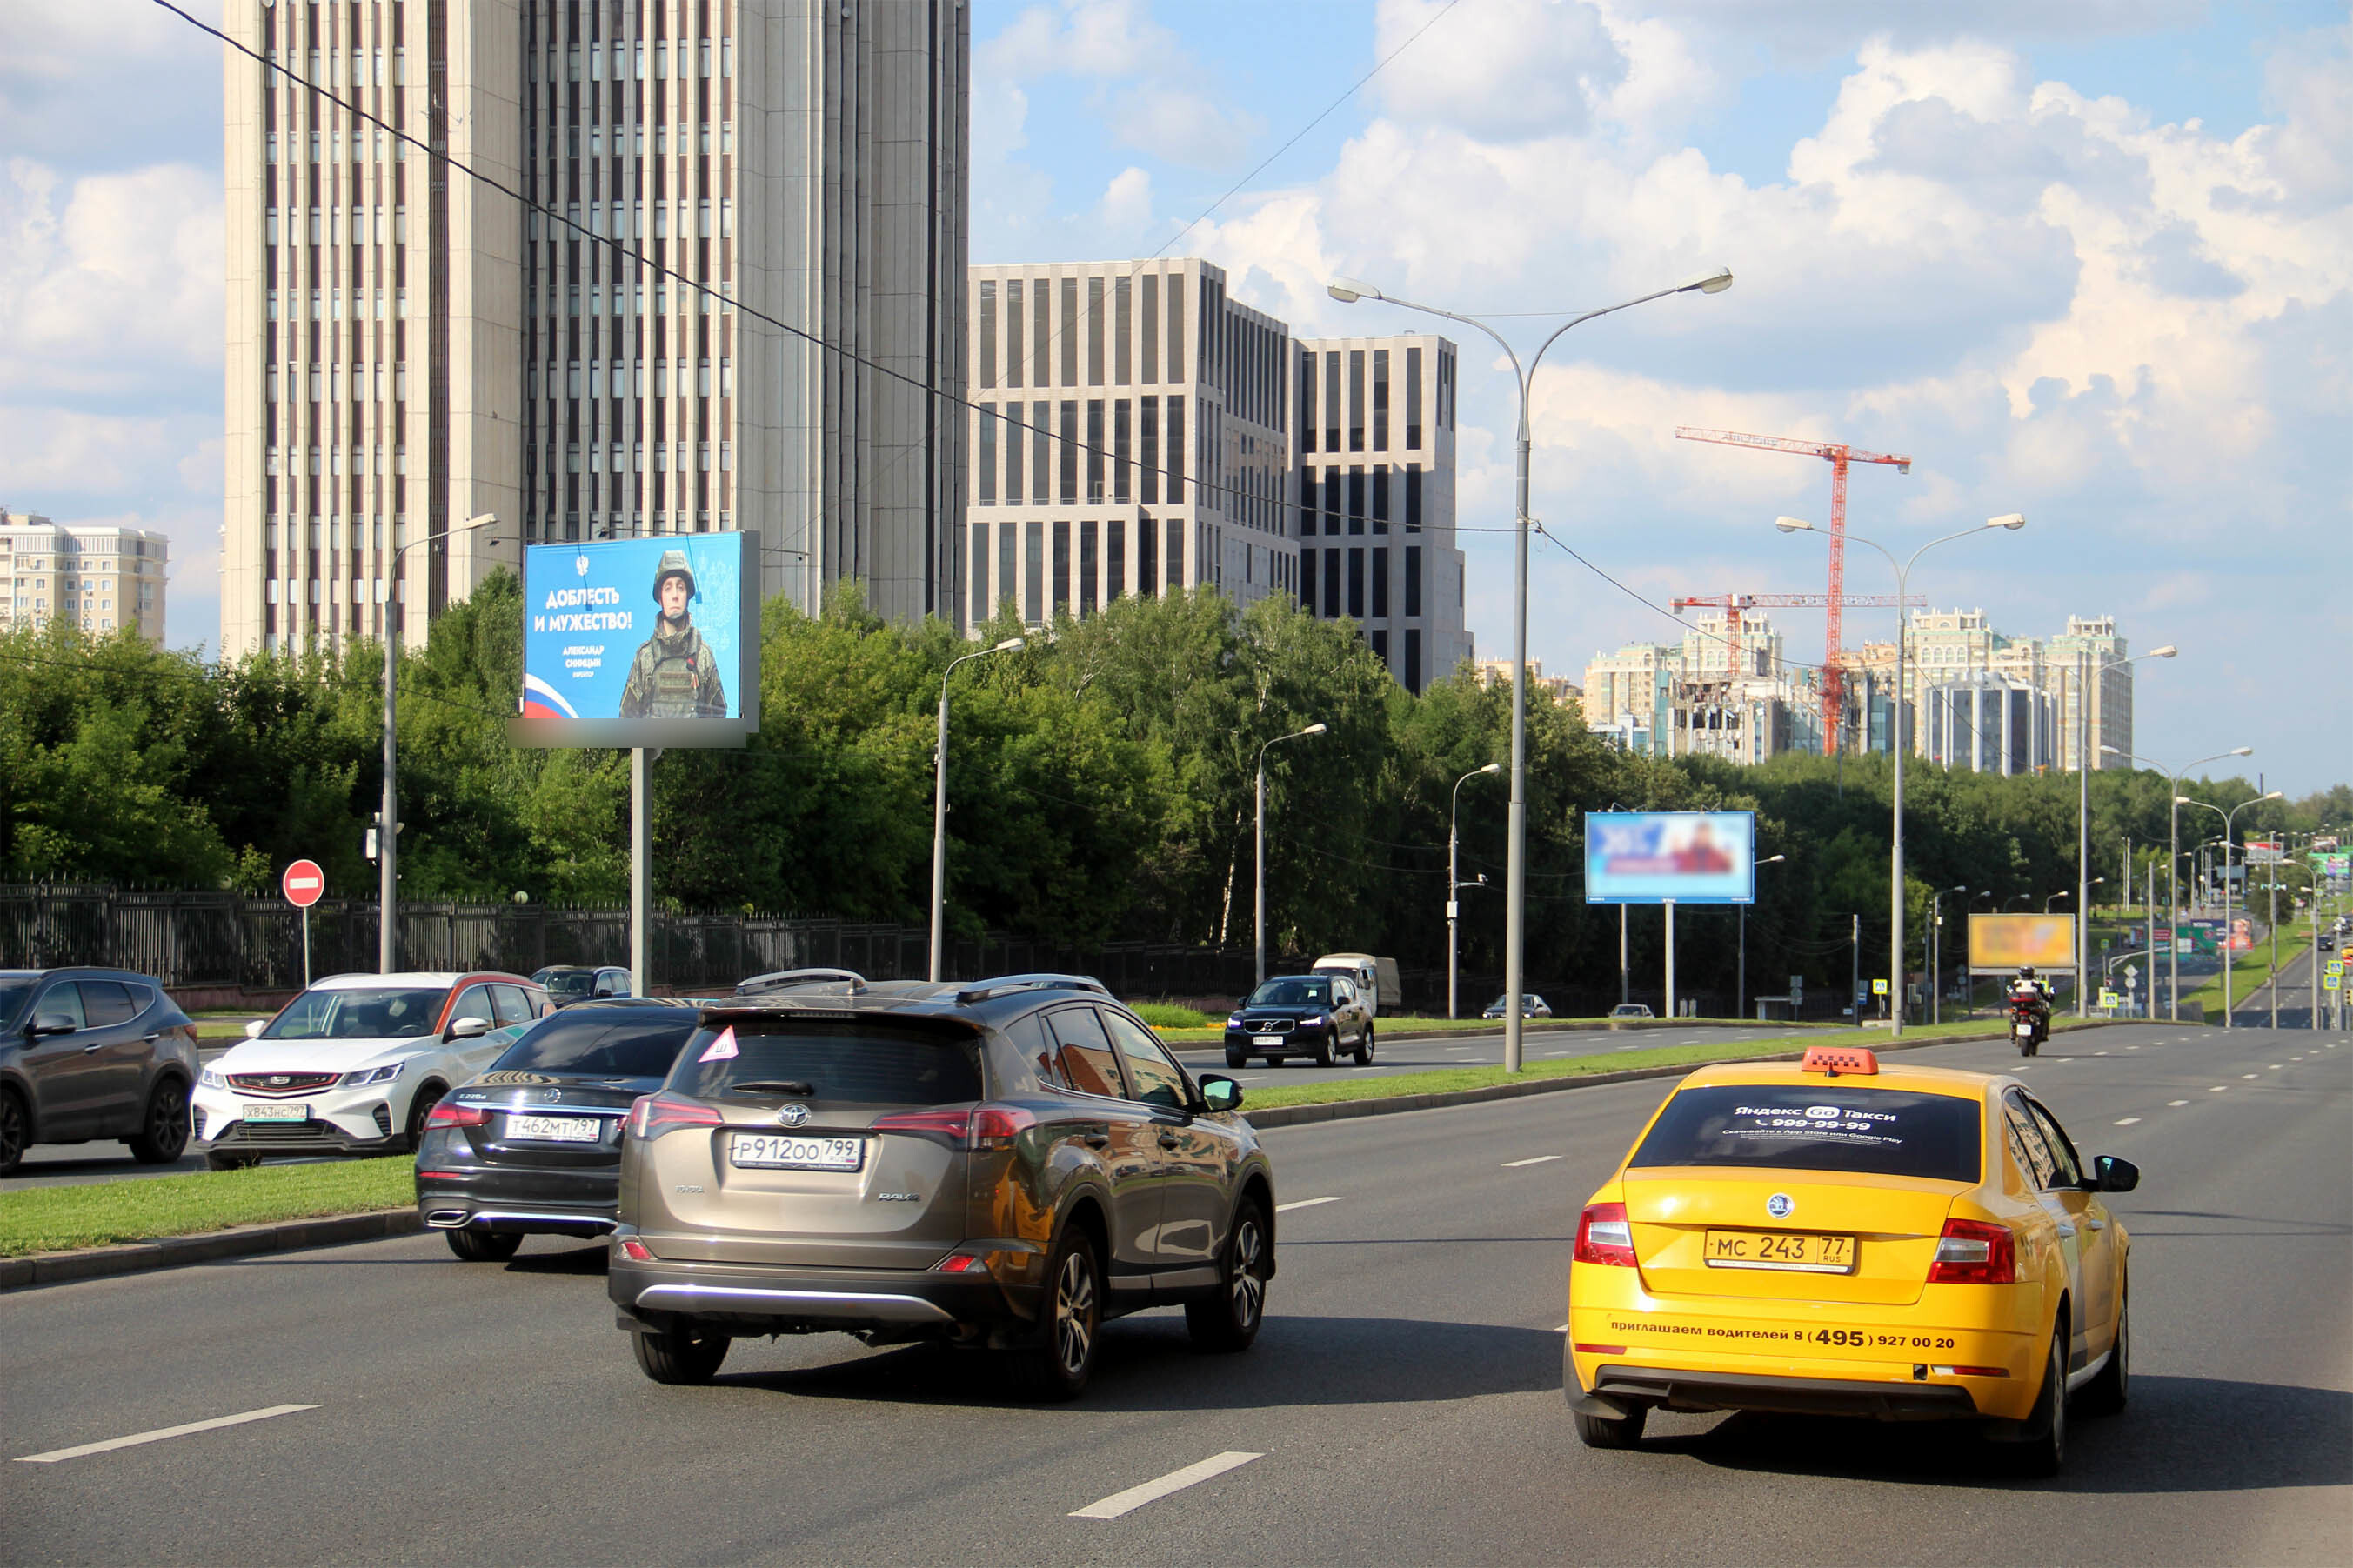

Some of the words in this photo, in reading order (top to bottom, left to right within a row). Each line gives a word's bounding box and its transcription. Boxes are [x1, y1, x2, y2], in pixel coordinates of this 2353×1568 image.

[545, 587, 620, 610] ДОБЛЕСТЬ
[534, 615, 545, 632] И
[549, 611, 632, 632] МУЖЕСТВО!
[563, 644, 605, 656] АЛЕКСАНДР
[716, 1043, 728, 1053] Ш
[1734, 1106, 1803, 1116] Яндекс
[1842, 1109, 1897, 1122] Такси
[573, 1118, 596, 1131] 797
[1771, 1118, 1871, 1131] 999-99-99
[825, 1139, 855, 1156] 799
[1717, 1238, 1748, 1257] МС
[1759, 1236, 1806, 1259] 243
[1822, 1237, 1845, 1255] 77
[1611, 1320, 1703, 1336] приглашаем
[1707, 1327, 1789, 1341] водителей
[1794, 1330, 1803, 1341] 8
[1878, 1335, 1907, 1346] 927
[1912, 1337, 1931, 1348] 00
[1935, 1338, 1955, 1349] 20
